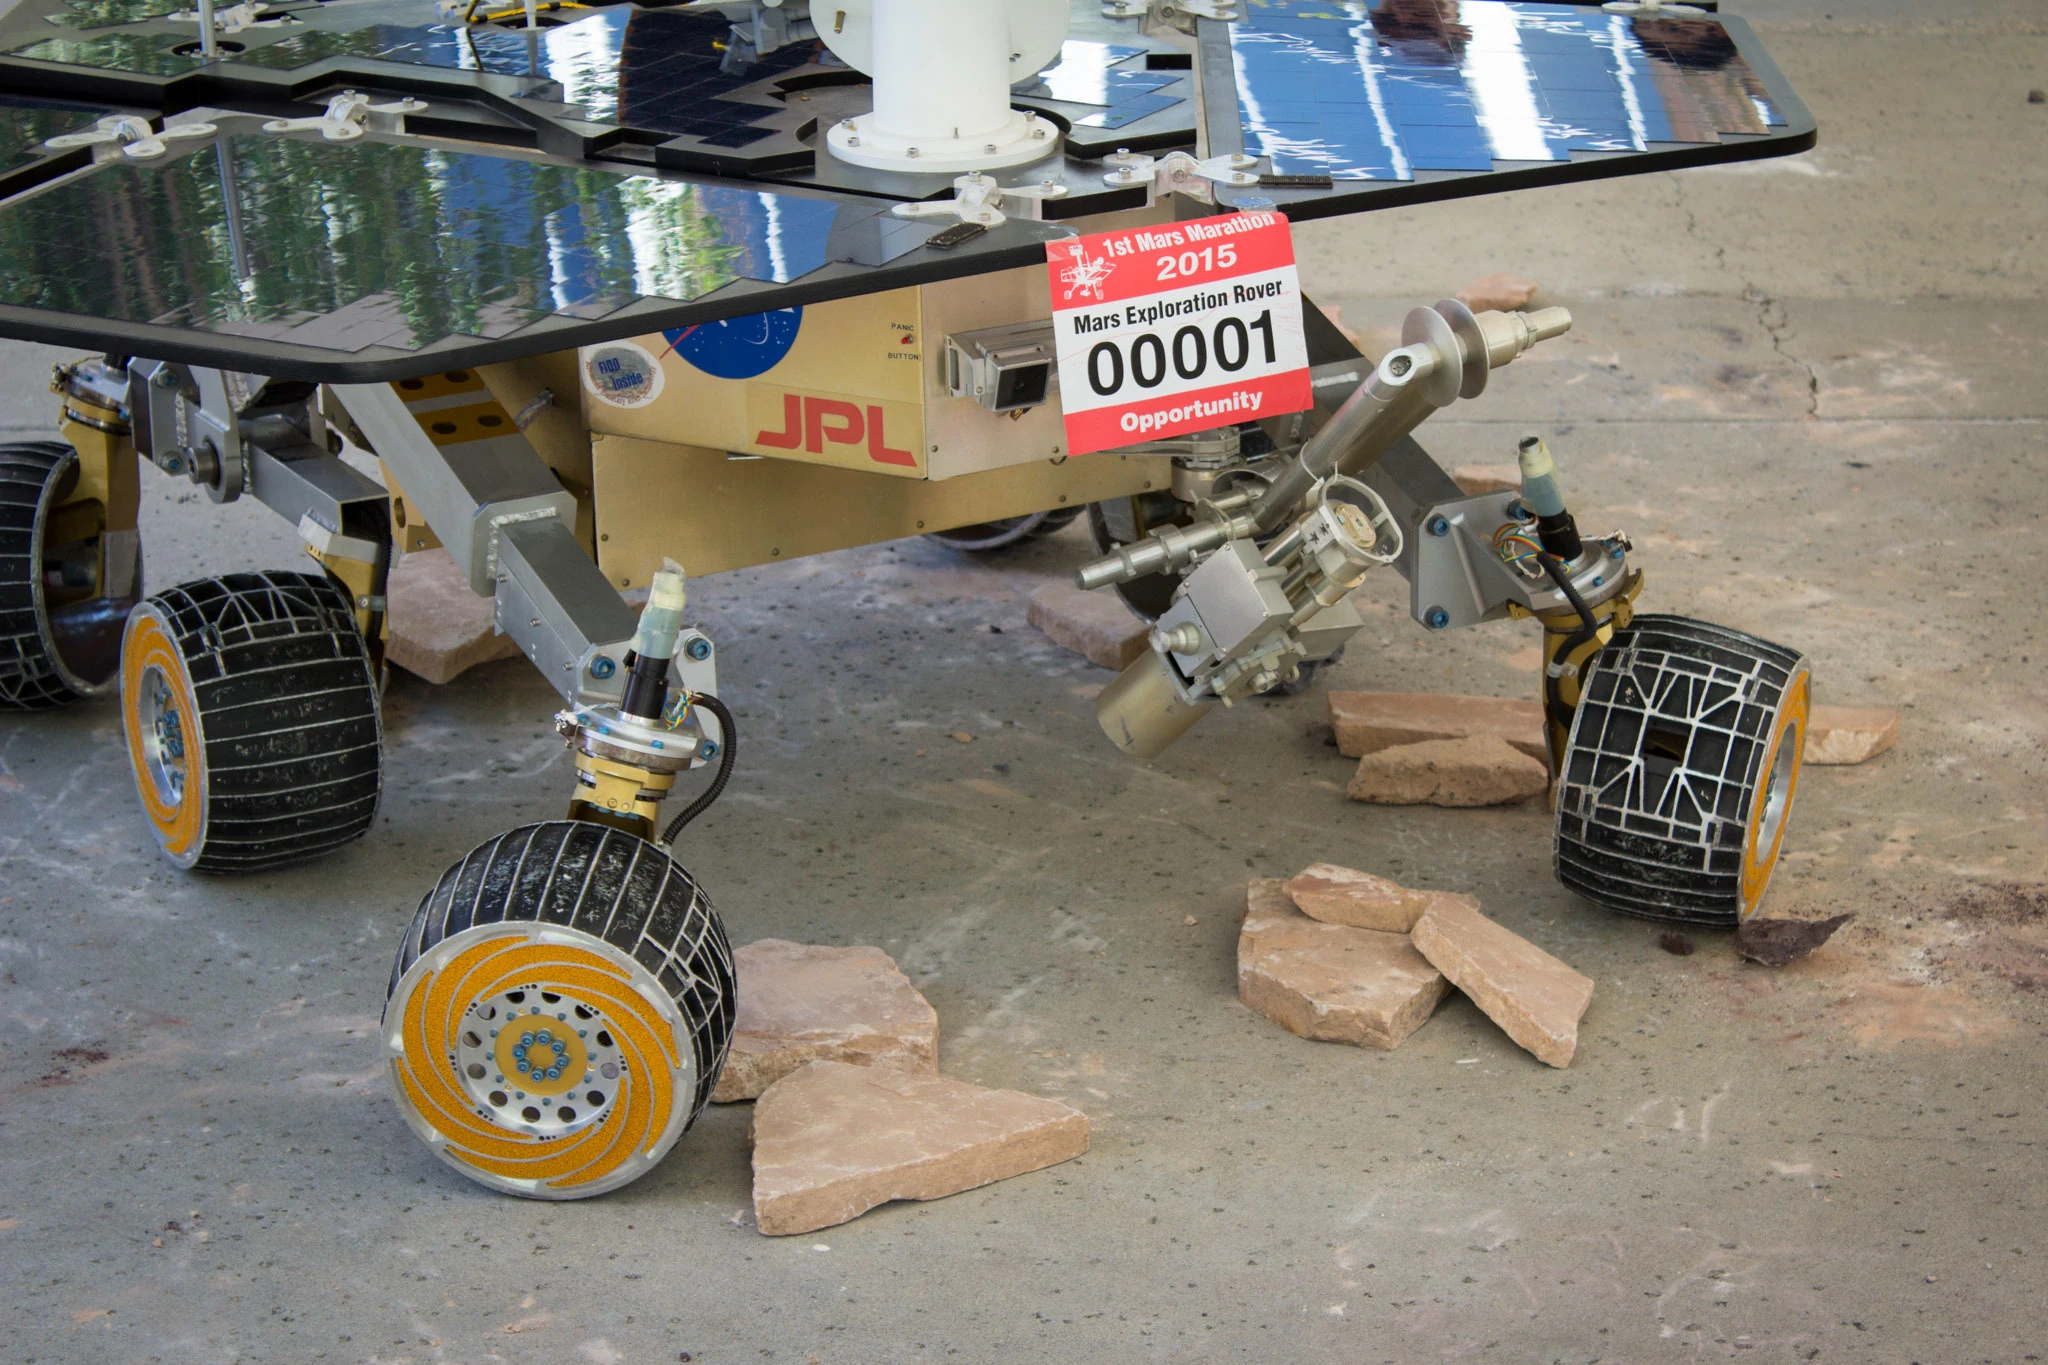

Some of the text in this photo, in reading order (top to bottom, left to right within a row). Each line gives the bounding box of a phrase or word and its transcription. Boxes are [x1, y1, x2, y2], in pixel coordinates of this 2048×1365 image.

[1102, 213, 1275, 258] 1st Mars Marathon
[1156, 243, 1238, 281] 2015
[891, 322, 915, 332] PANIC
[1073, 280, 1282, 334] Mars Exploration Rover
[887, 352, 919, 361] BUTTON
[1087, 309, 1276, 397] 00001
[754, 393, 917, 467] JPL
[1120, 391, 1263, 433] Opportunity
